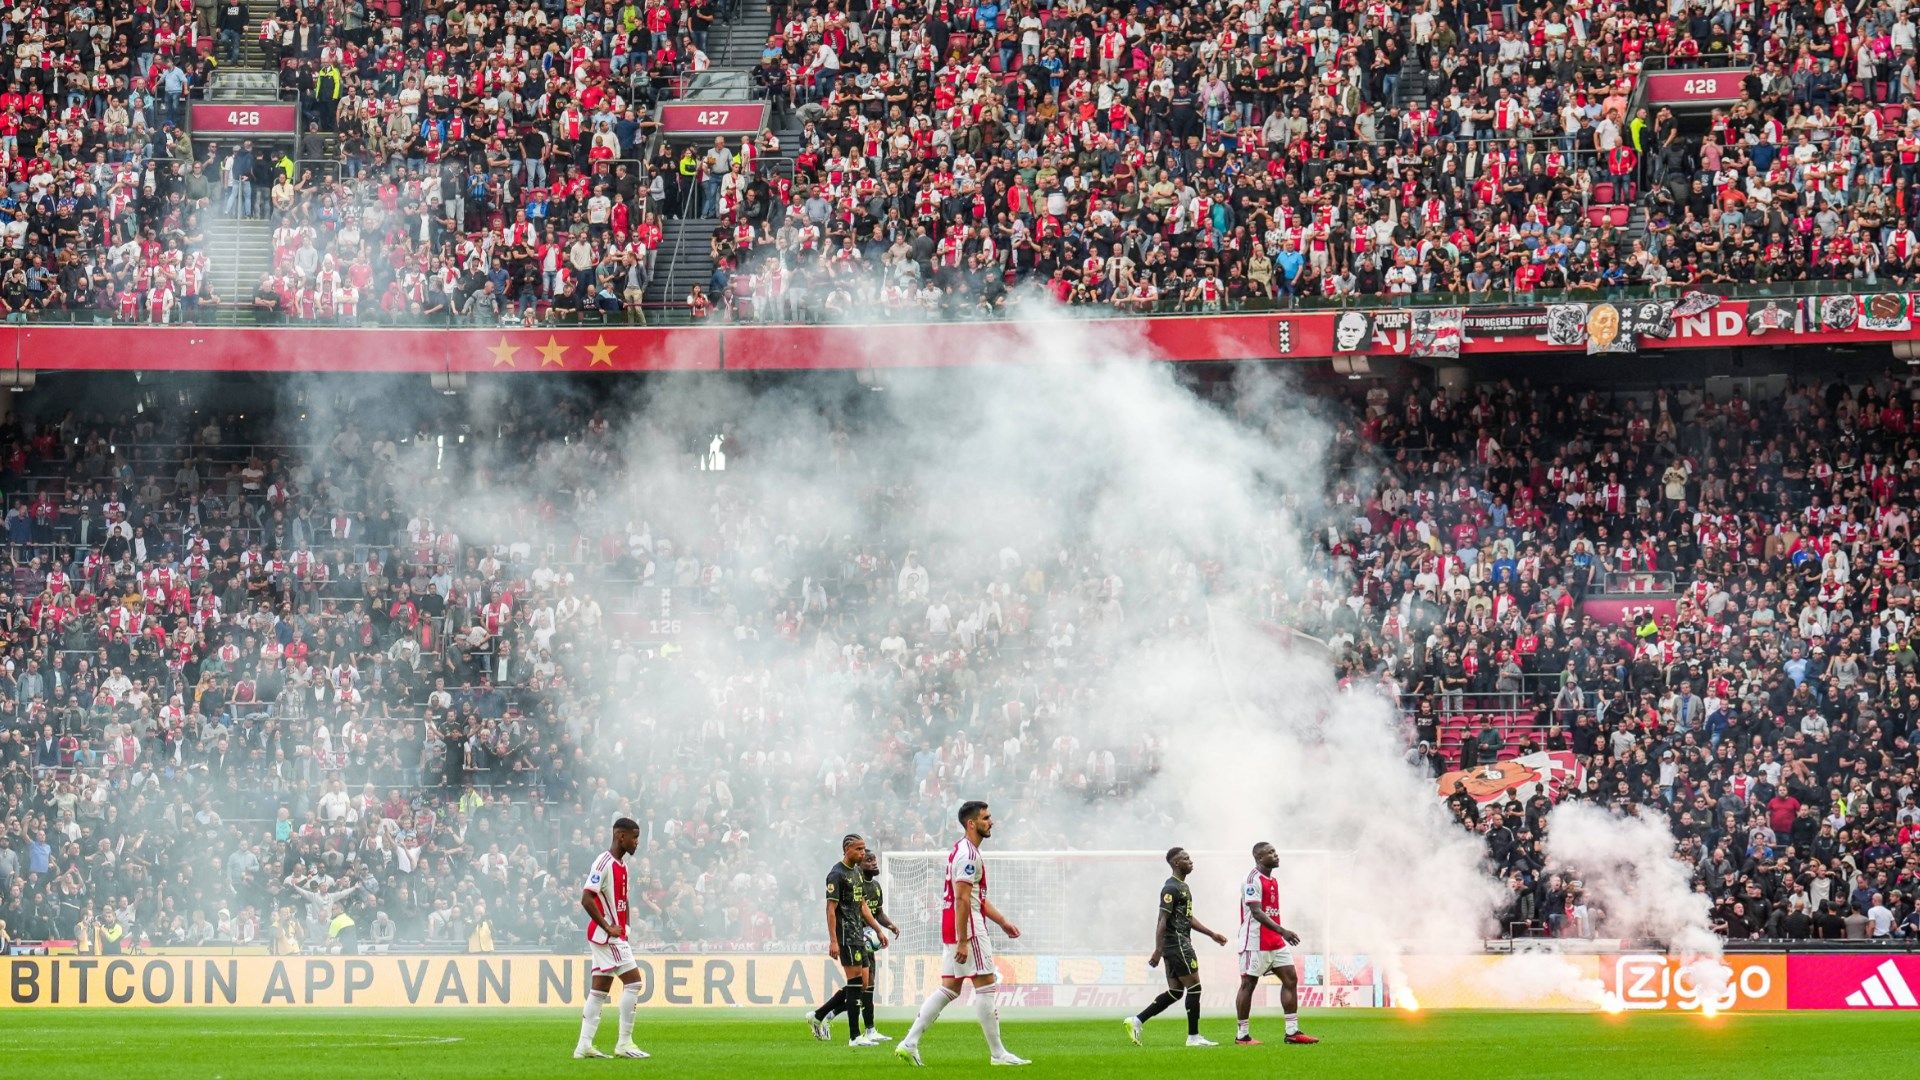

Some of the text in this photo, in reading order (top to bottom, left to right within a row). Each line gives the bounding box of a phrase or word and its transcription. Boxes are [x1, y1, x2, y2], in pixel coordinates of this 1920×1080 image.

[1683, 79, 1717, 94] 428
[227, 111, 260, 126] 426
[697, 111, 730, 126] 427
[1375, 313, 1410, 325] ULTRAS
[1475, 317, 1511, 327] JONGENS
[1511, 316, 1530, 326] MET
[1530, 315, 1548, 325] ONS
[650, 619, 681, 634] 126
[10, 960, 238, 1004] BITCOIN
[262, 960, 375, 1004] APP
[397, 960, 511, 1004] VAN
